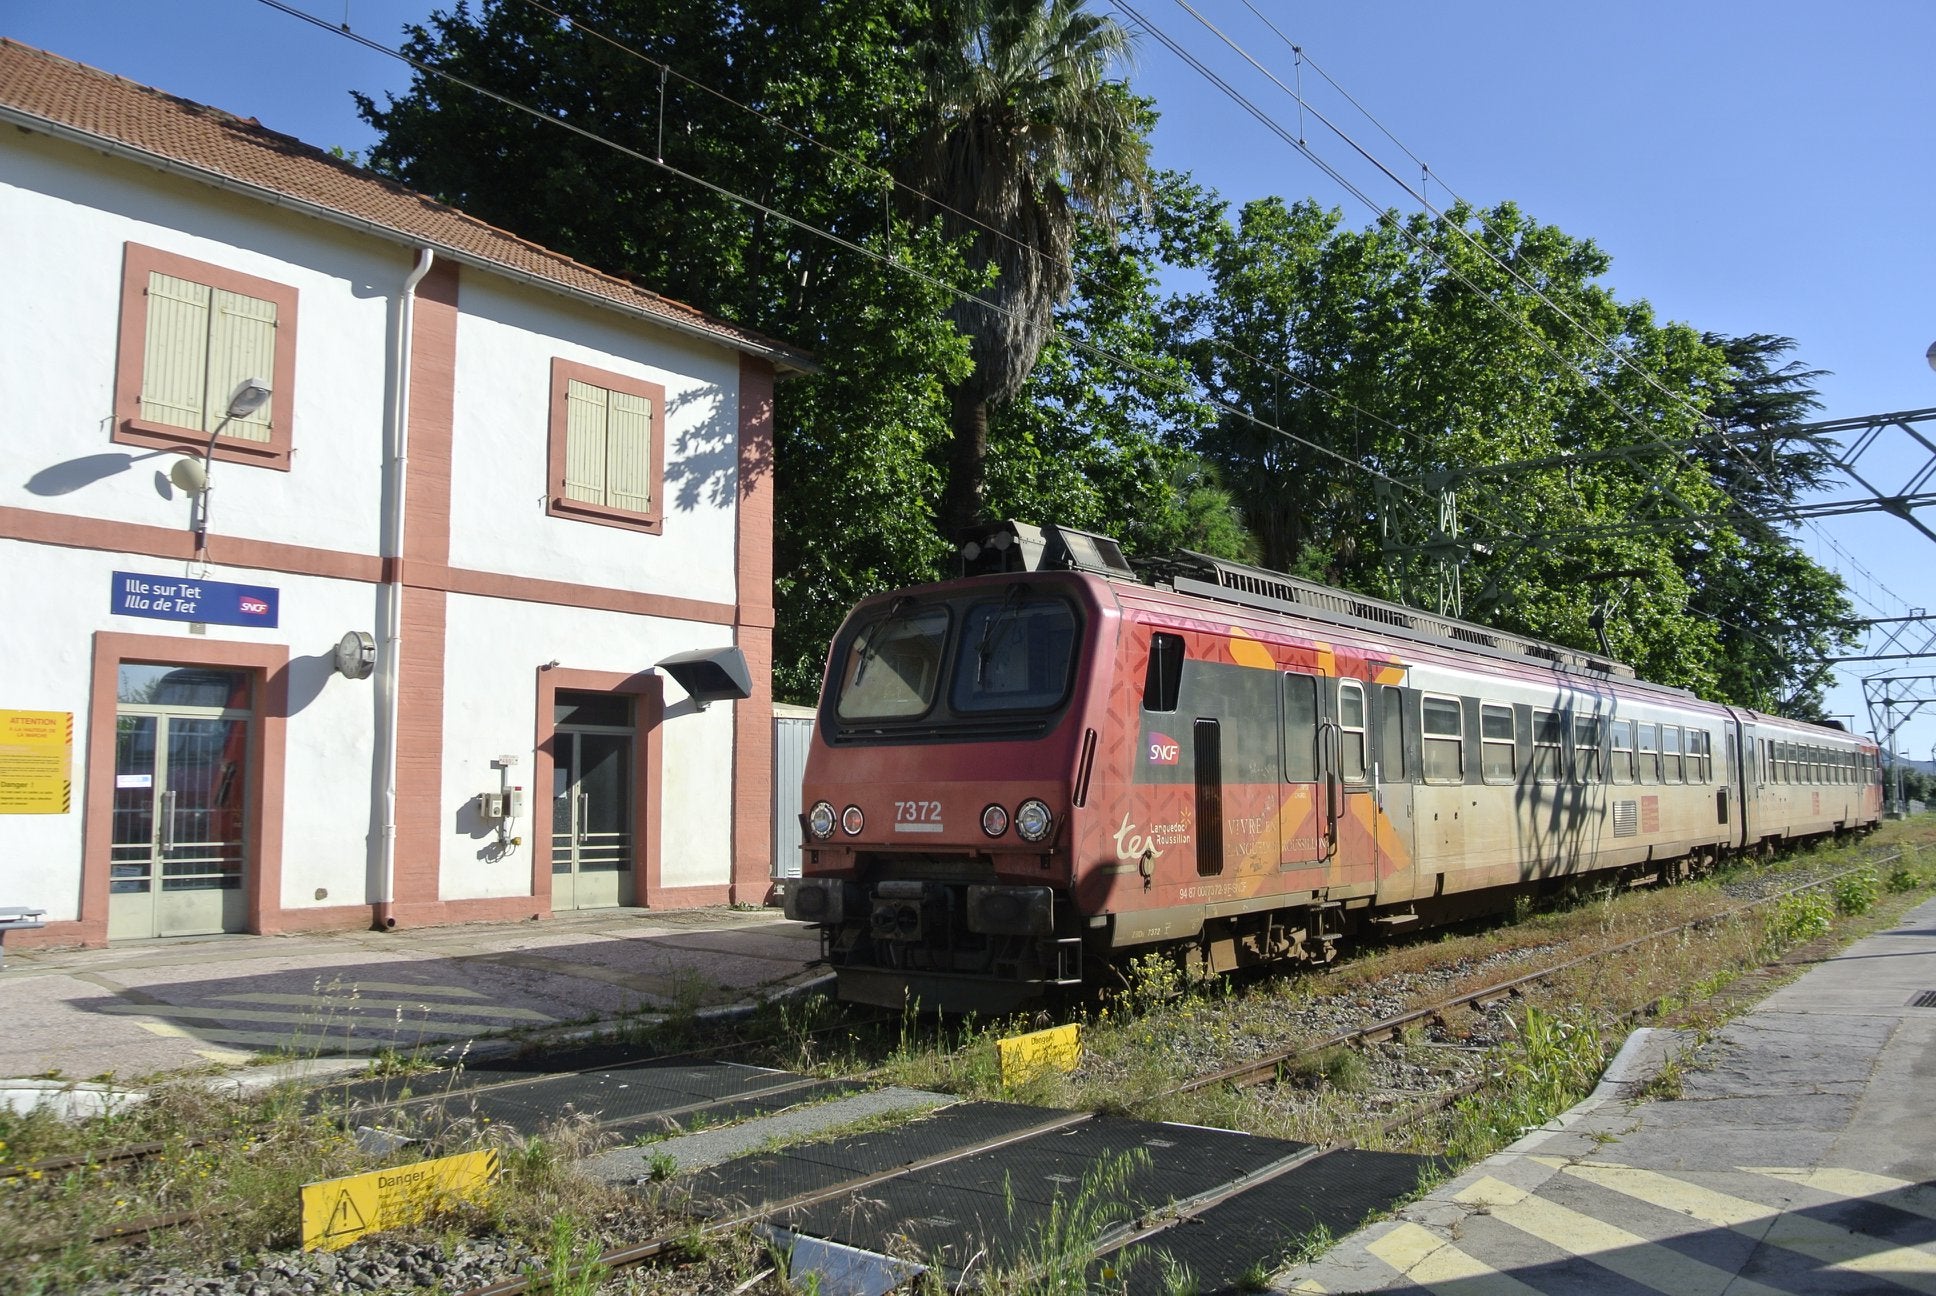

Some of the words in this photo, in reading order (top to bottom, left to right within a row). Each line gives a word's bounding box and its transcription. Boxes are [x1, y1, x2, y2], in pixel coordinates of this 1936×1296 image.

[125, 579, 148, 594] Ille
[153, 584, 176, 596] sur
[178, 584, 202, 599] Tet
[125, 595, 149, 610] Illa
[153, 598, 172, 612] de
[175, 599, 197, 614] Tet
[240, 602, 269, 613] SNCF
[9, 717, 57, 726] ATTENTION
[1150, 744, 1178, 761] SNCF
[0, 781, 28, 789] Danger
[895, 801, 942, 821] 7372
[1156, 835, 1191, 845] Roussillon
[378, 1170, 425, 1189] Danger
